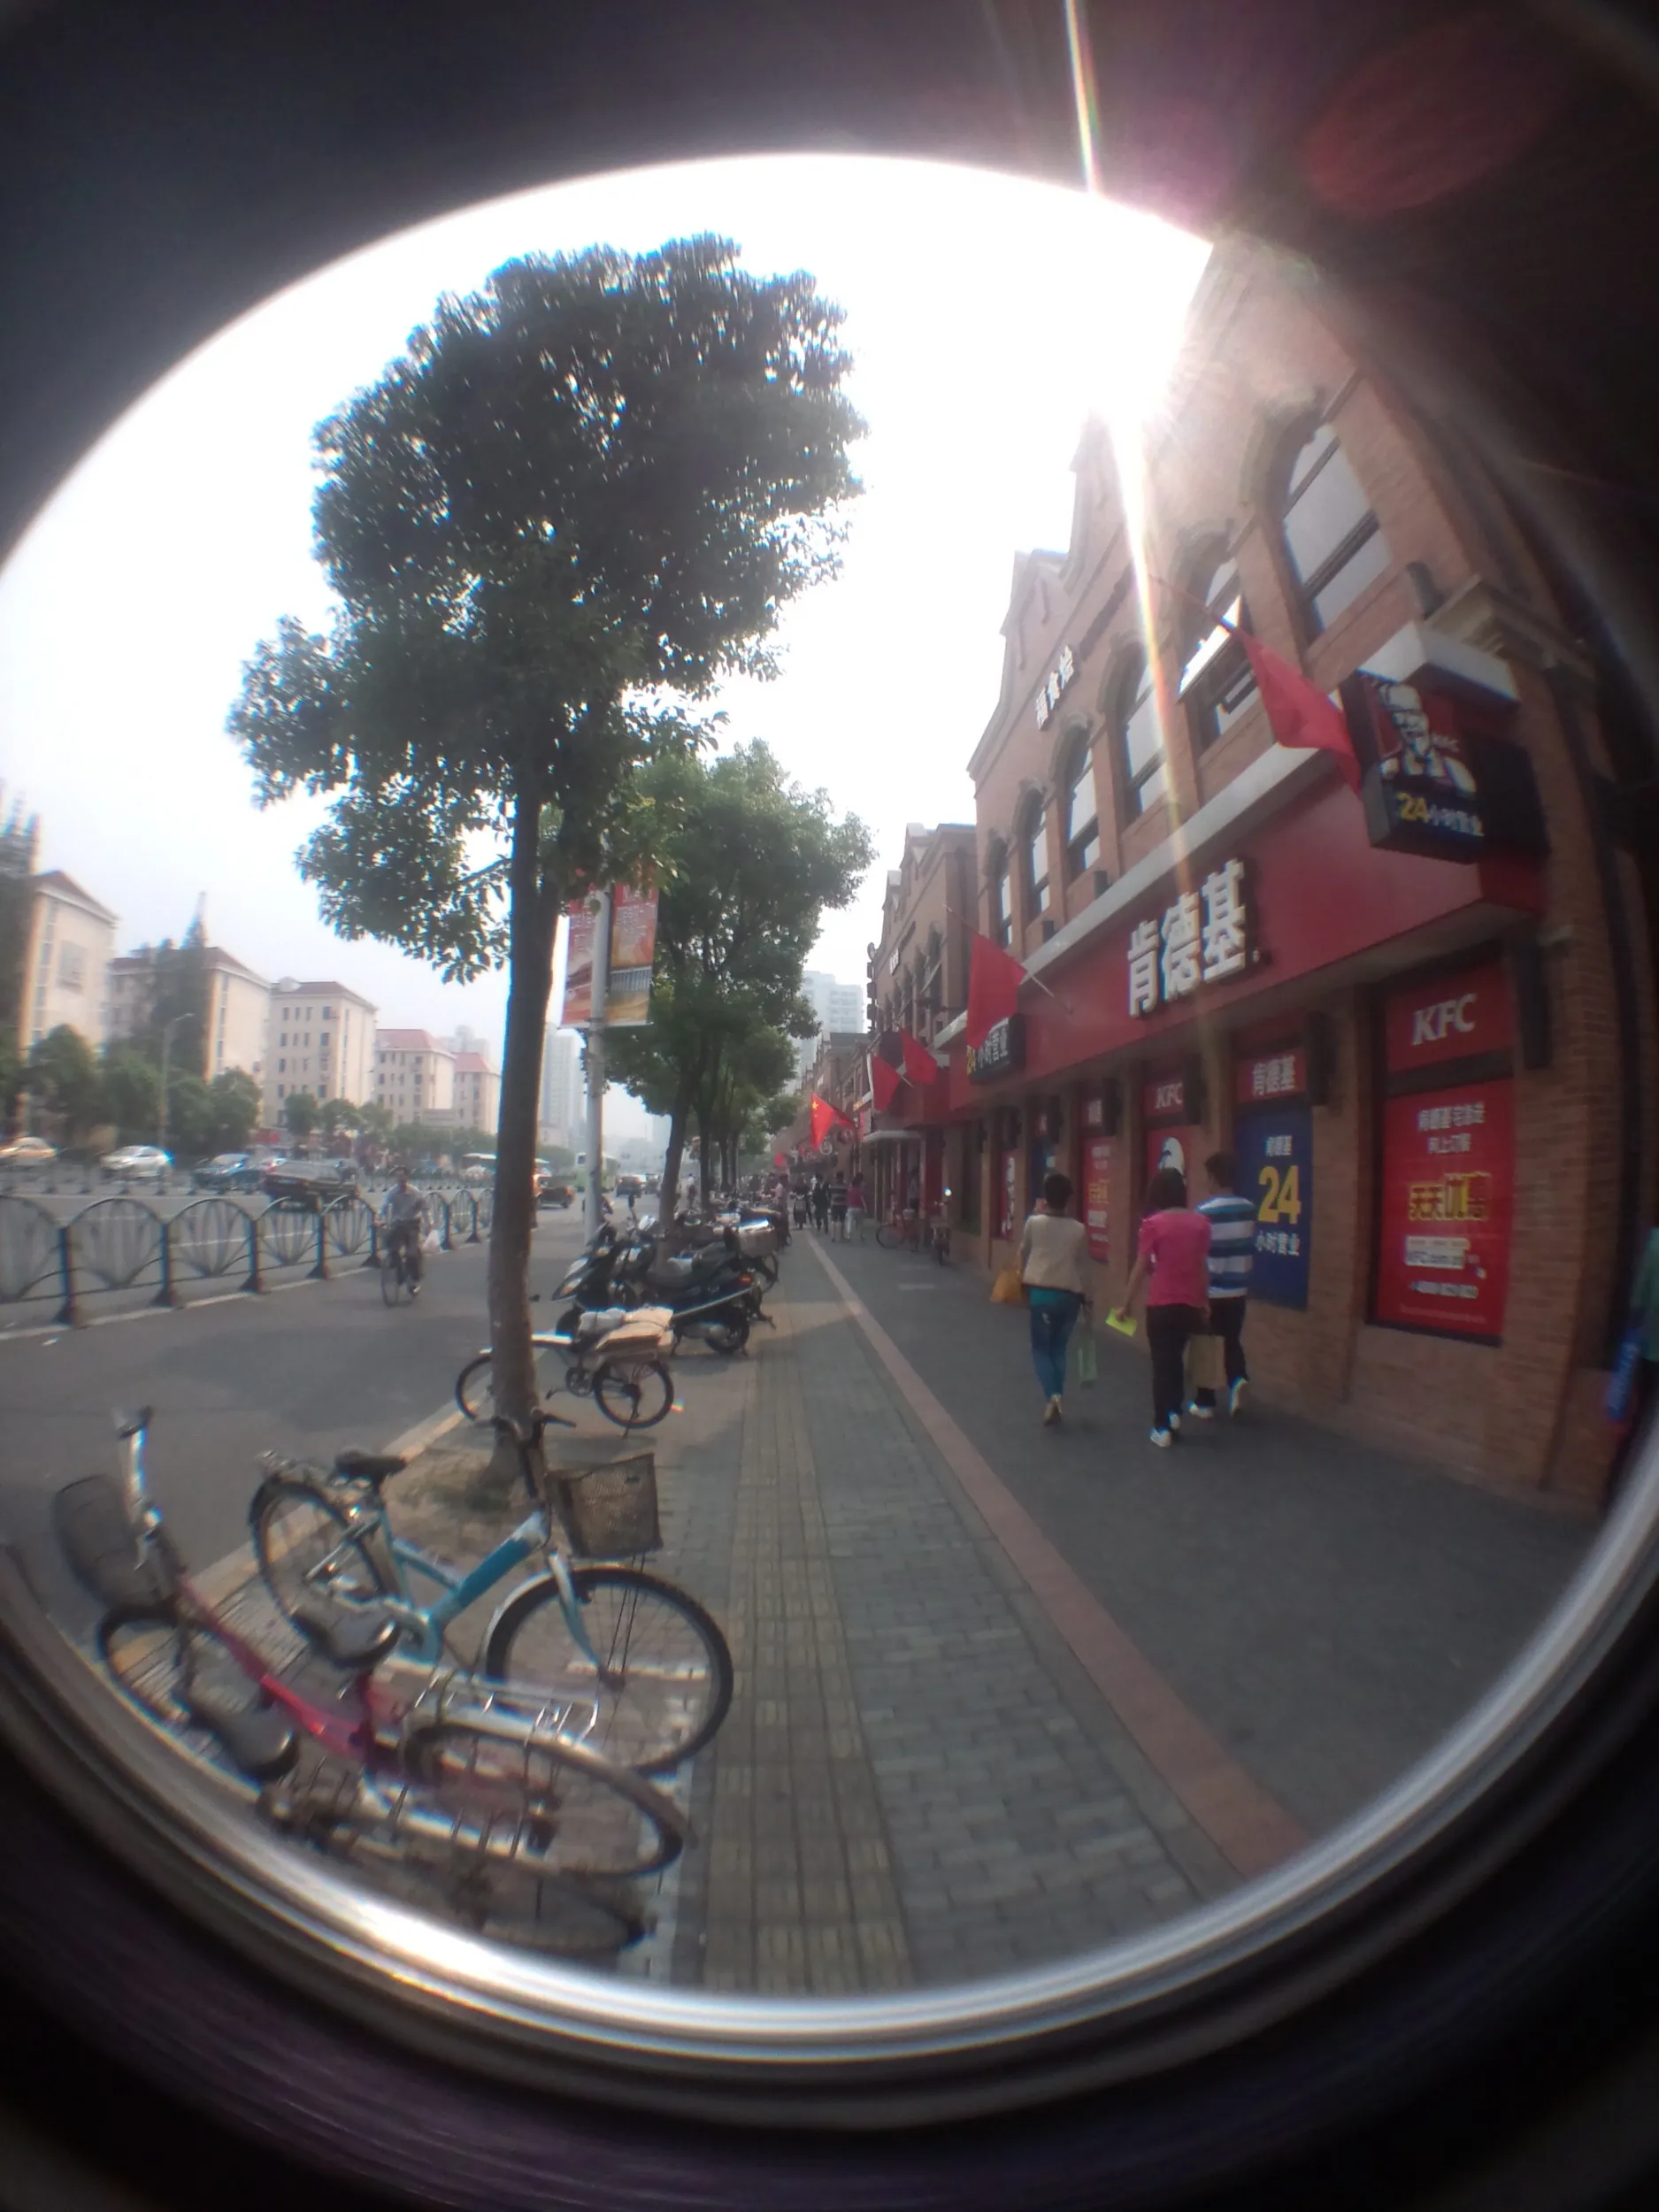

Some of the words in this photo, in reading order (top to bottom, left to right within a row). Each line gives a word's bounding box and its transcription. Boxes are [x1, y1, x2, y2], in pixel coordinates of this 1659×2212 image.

[1127, 858, 1247, 1018] 肯德基
[1411, 993, 1479, 1046] KFC
[1155, 1082, 1183, 1110] KFC
[1252, 1055, 1296, 1096] 肯德基
[1265, 1135, 1293, 1156] 肯德基
[1257, 1164, 1302, 1225] 24
[1255, 1230, 1301, 1256] 小时营业
